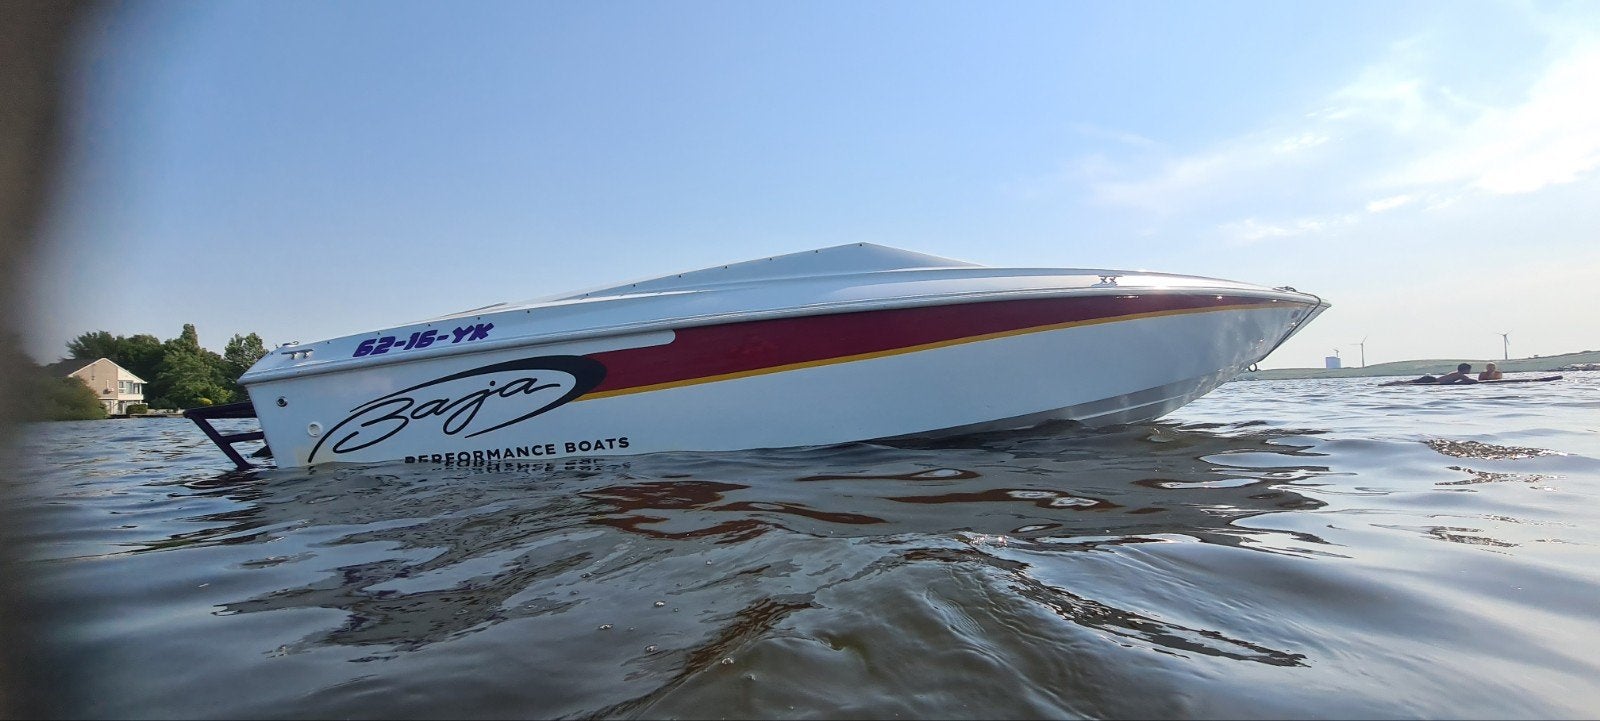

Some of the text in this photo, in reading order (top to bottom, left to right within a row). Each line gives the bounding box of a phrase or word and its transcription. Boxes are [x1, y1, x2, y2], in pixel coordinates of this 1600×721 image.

[352, 322, 495, 358] 62-16-YK
[309, 375, 562, 463] Baja
[564, 436, 630, 454] BOATS
